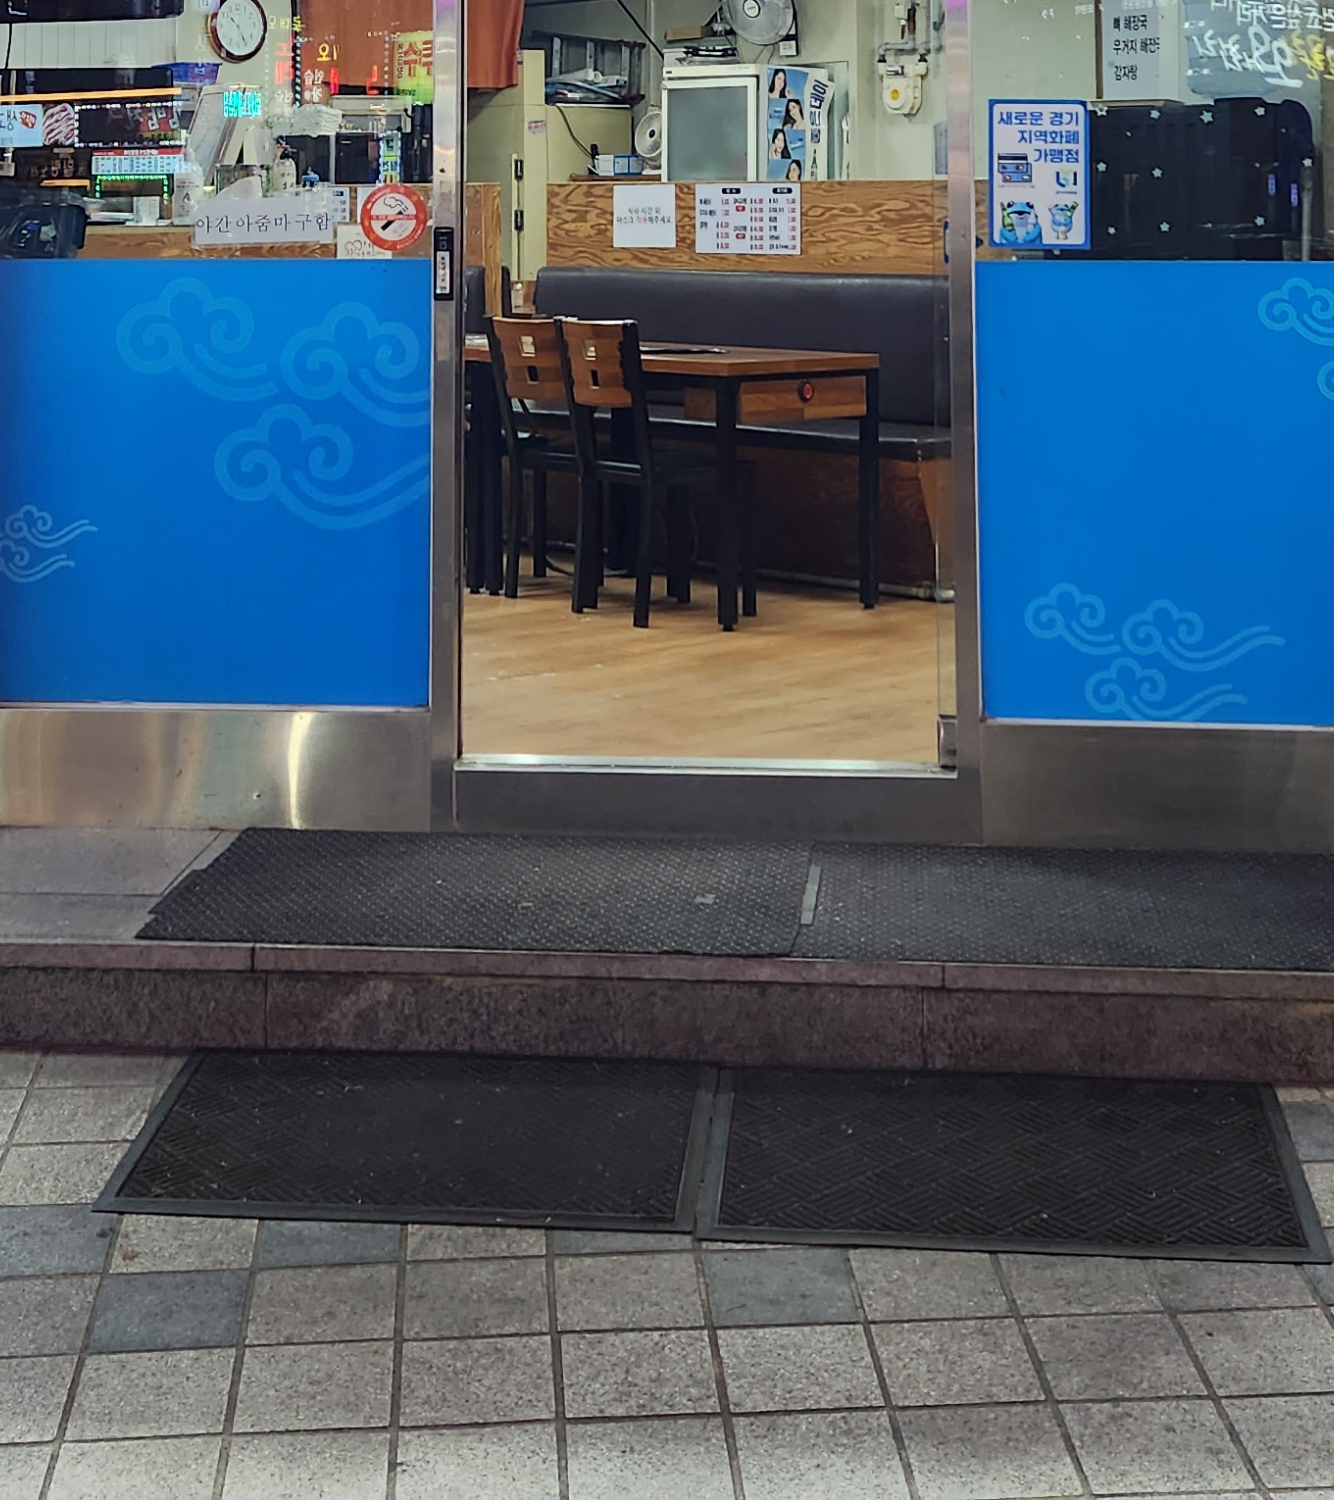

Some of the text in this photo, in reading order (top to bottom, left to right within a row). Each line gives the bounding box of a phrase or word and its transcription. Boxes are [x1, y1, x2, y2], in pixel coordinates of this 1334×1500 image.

[1140, 36, 1160, 53] 해장
[998, 111, 1079, 126] 새로운 경기
[1018, 130, 1080, 145] 지역화폐
[1033, 148, 1080, 164] 가맹점
